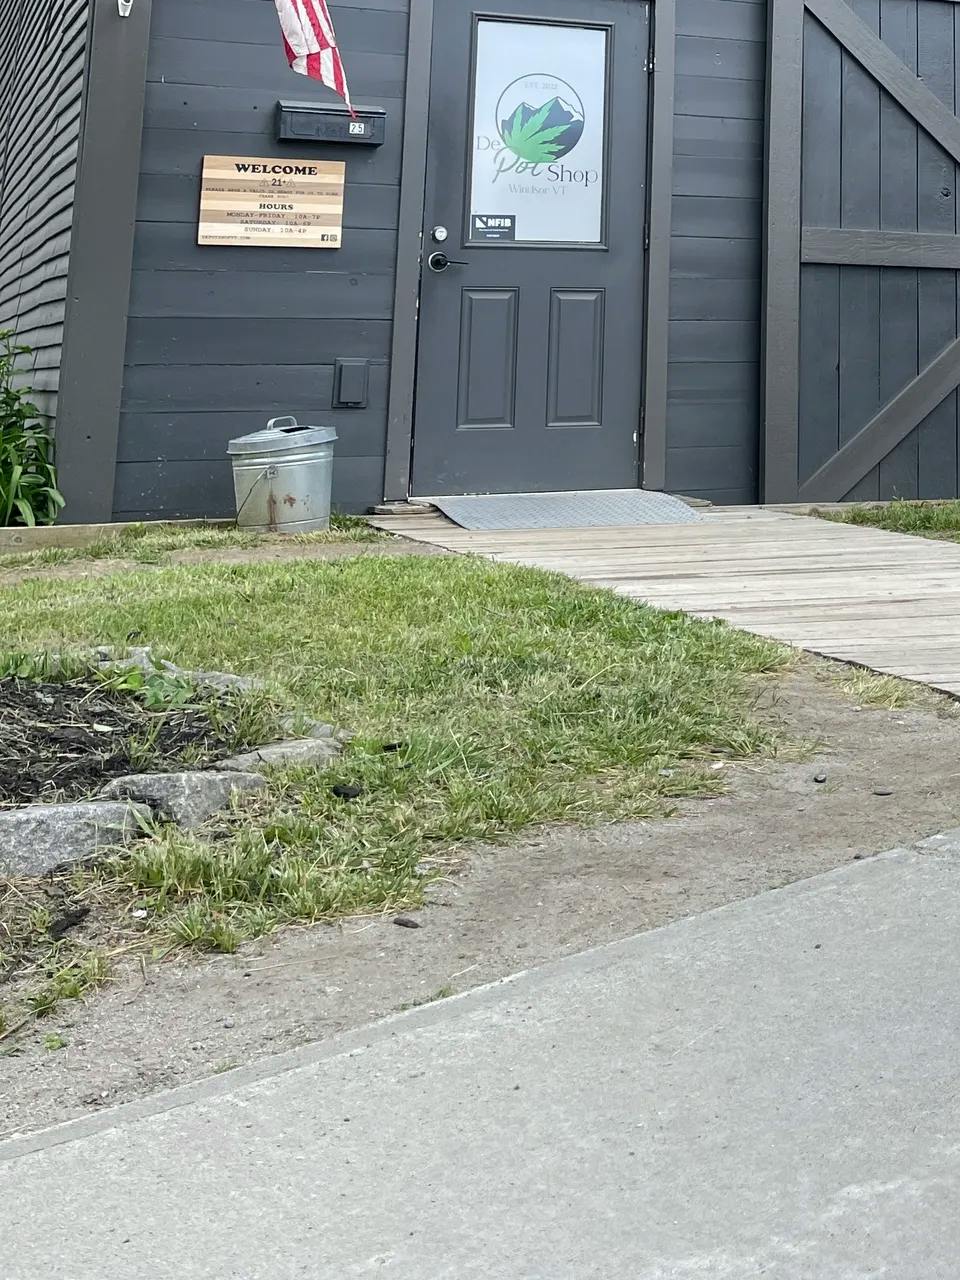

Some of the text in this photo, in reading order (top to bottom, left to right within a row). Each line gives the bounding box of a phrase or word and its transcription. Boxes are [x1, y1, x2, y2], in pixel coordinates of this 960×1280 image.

[351, 123, 363, 133] 25
[476, 135, 501, 151] De
[234, 163, 318, 176] WELCOME
[492, 146, 556, 184] Pot
[547, 163, 599, 187] Shop
[271, 178, 287, 187] 21+
[552, 184, 567, 196] VT
[258, 203, 294, 211] HOURS
[487, 218, 512, 227] NFIB
